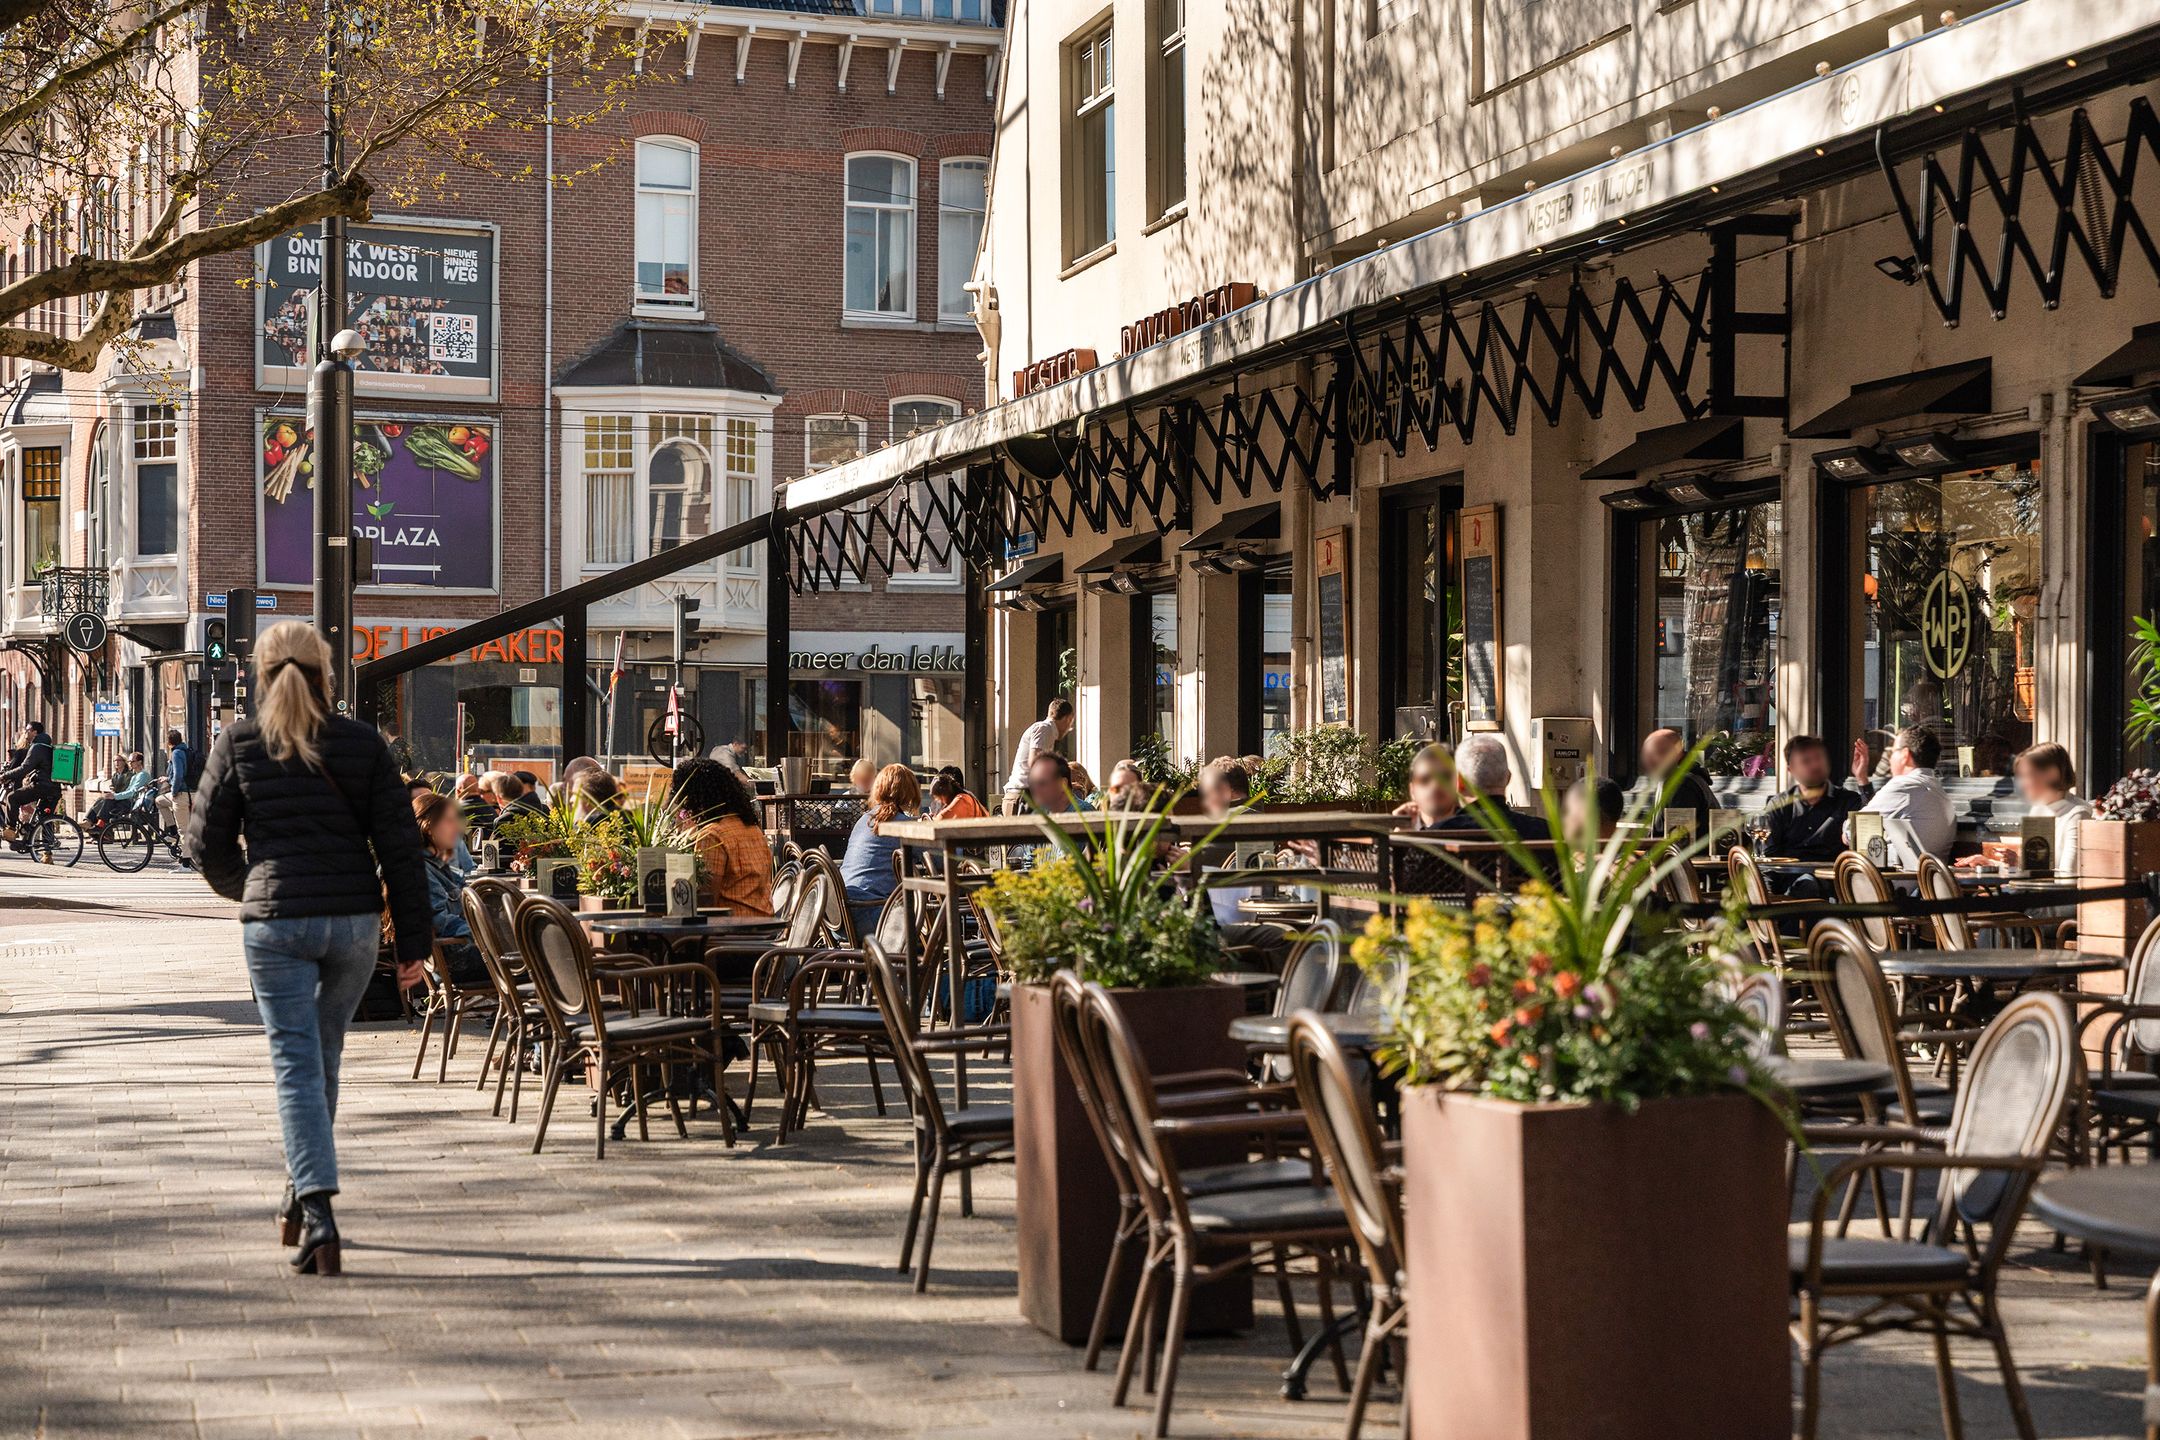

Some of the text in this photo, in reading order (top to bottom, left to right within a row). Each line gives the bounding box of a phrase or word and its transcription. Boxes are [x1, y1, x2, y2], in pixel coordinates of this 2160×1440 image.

[1526, 161, 1654, 236] WESTER PAVILJOEN
[369, 243, 420, 263] WEST
[443, 248, 478, 259] NIEUWE
[443, 257, 478, 268] BINNEN
[288, 256, 418, 282] BINNDOOR
[443, 267, 478, 283] WEG
[1180, 317, 1255, 366] WESTER PAVILJOEN
[209, 596, 226, 604] Nieu
[789, 651, 854, 670] meer
[858, 643, 906, 670] dan
